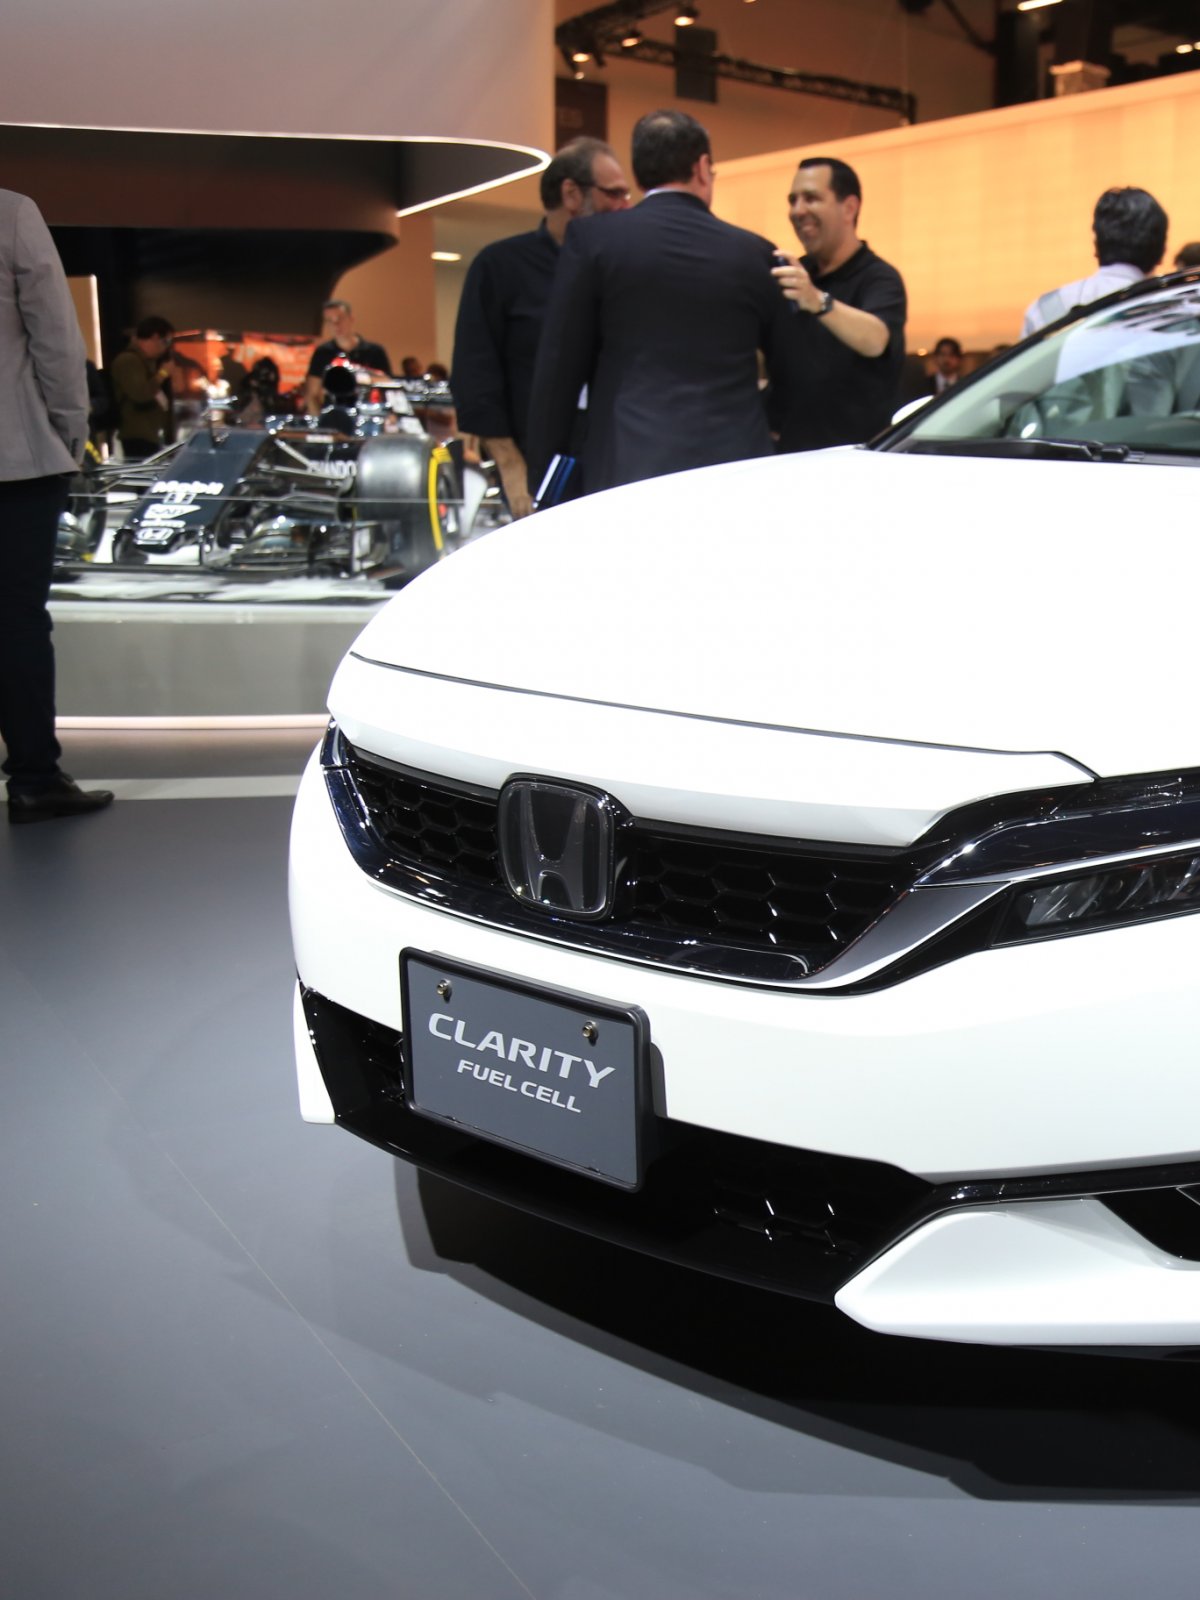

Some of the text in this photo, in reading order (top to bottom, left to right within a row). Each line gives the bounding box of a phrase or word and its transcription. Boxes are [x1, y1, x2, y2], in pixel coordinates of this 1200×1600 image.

[428, 1012, 616, 1089] CLARITY
[457, 1059, 582, 1113] FUEL CELL
